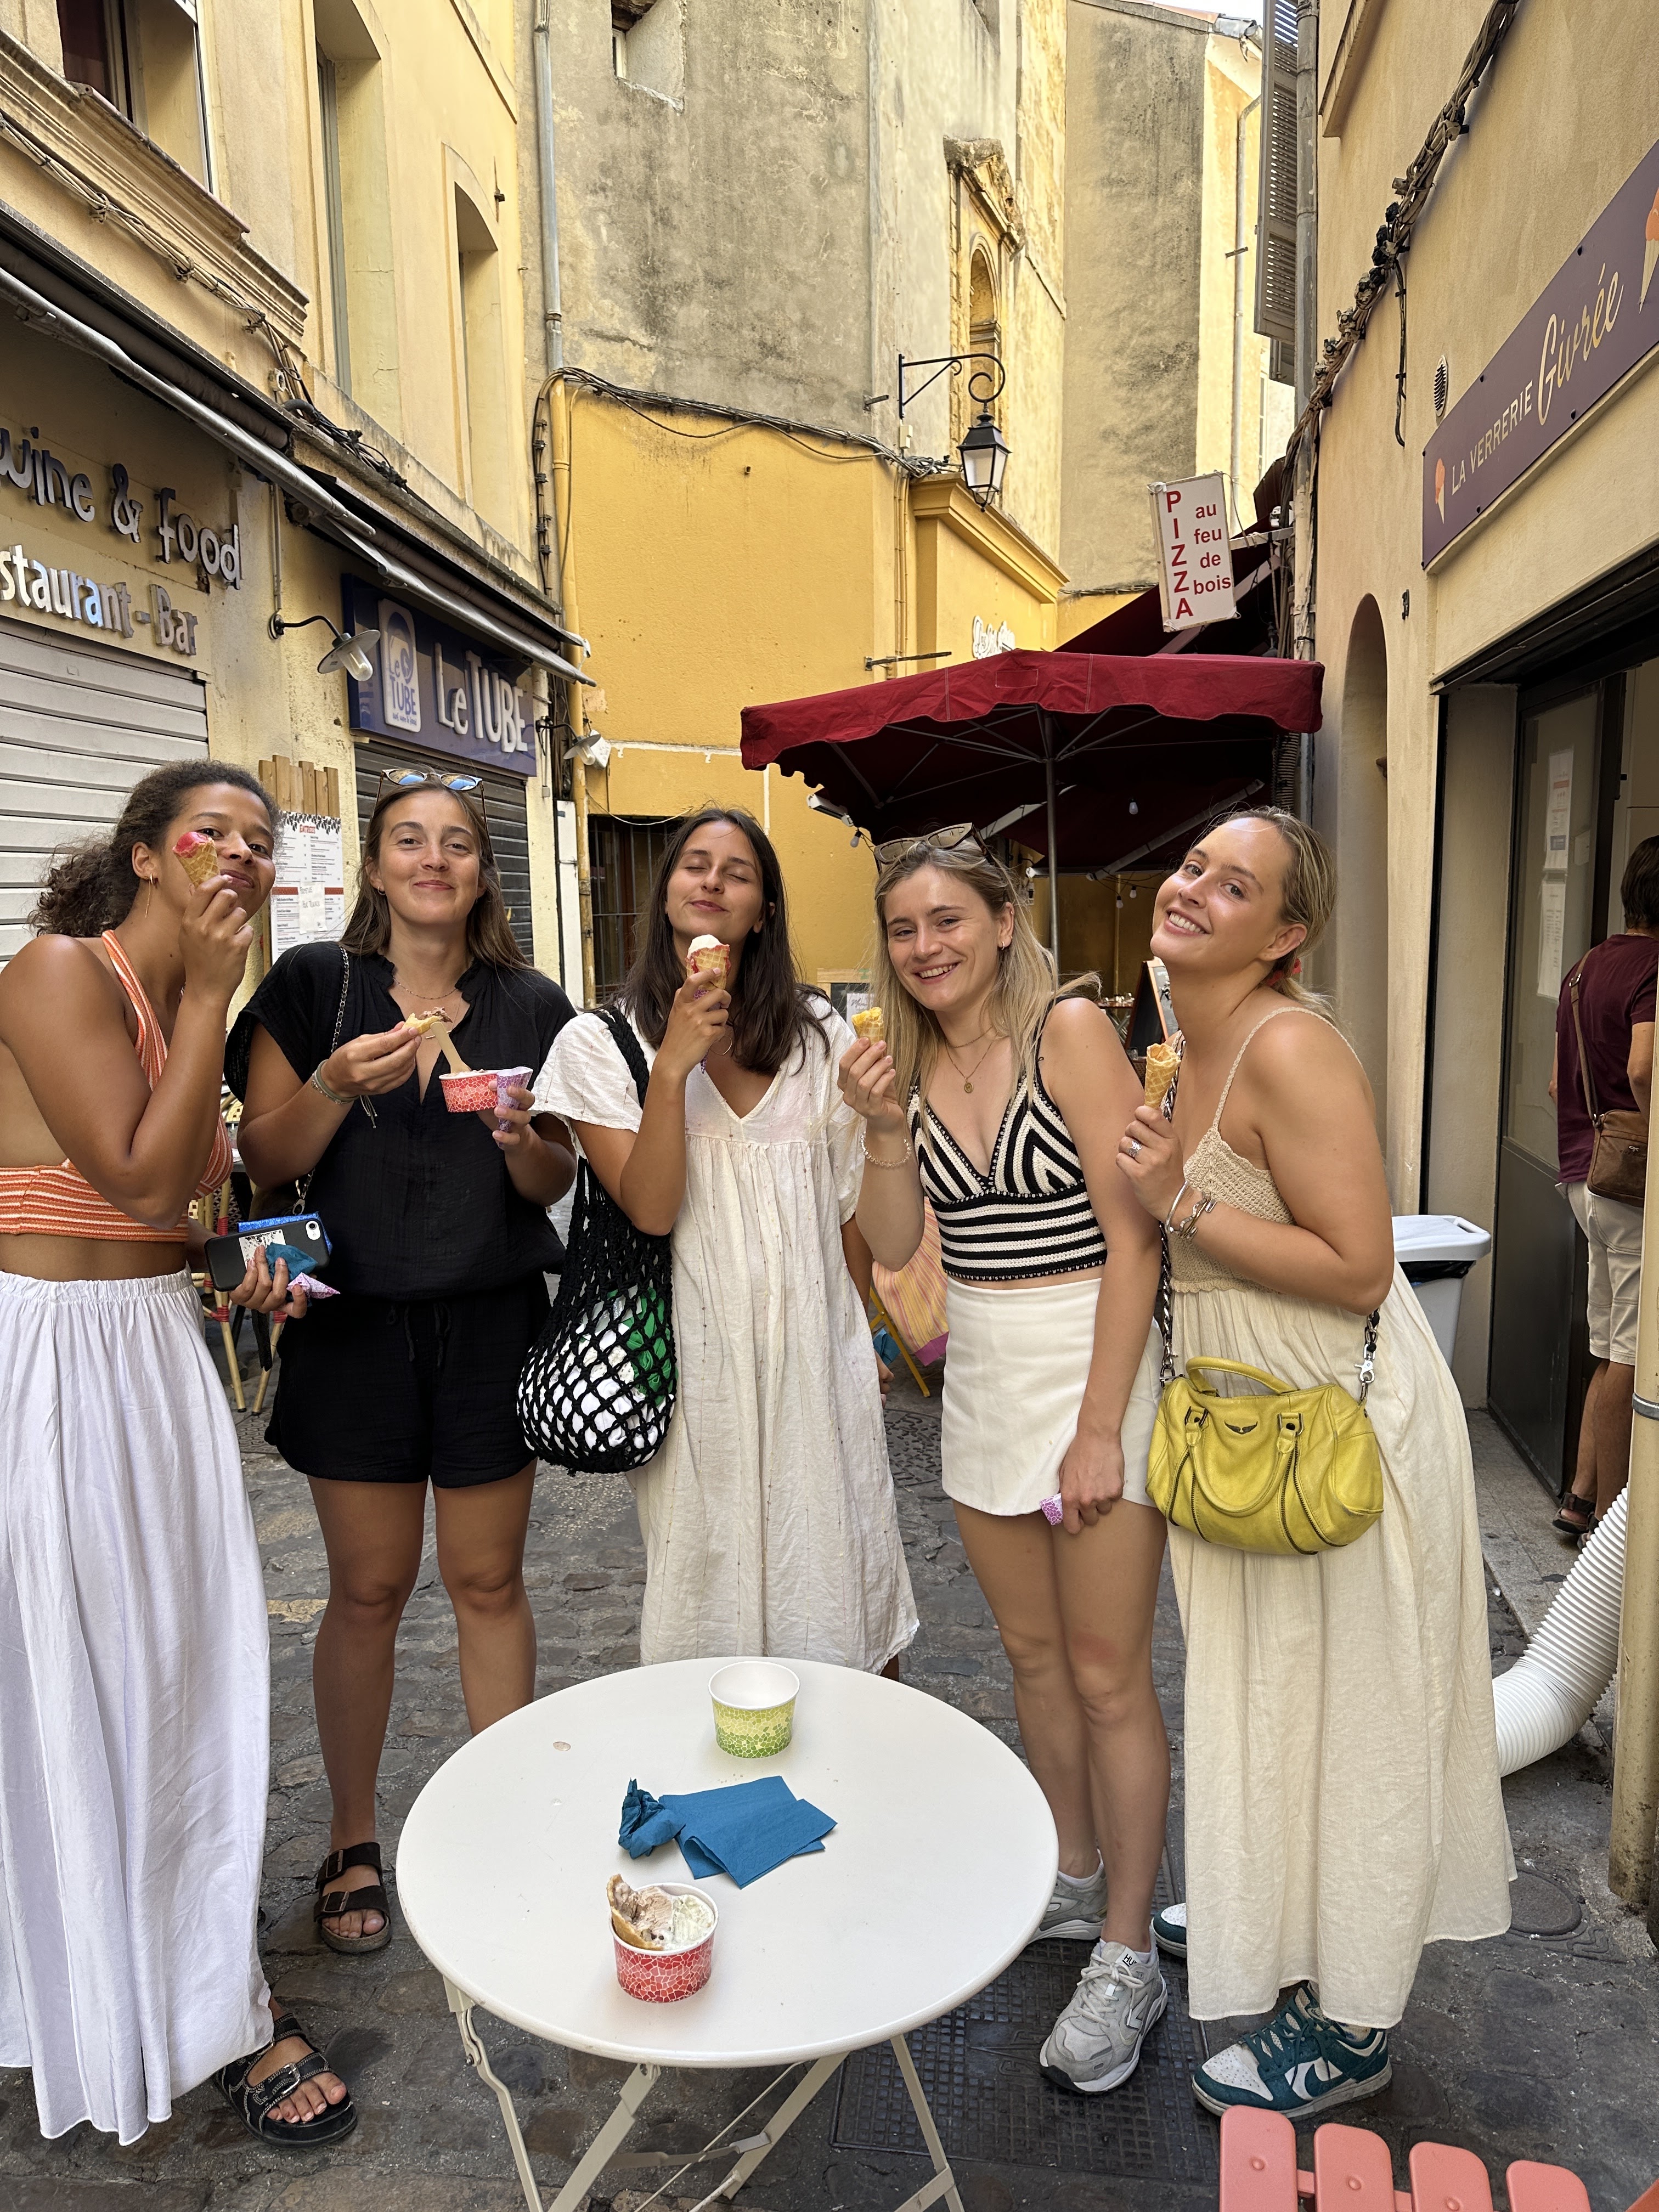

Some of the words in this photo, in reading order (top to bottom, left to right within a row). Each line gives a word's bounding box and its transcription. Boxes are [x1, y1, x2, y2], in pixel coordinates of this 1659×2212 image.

[1452, 460, 1466, 495] LA
[1470, 380, 1533, 474] VERRERIE
[1538, 262, 1624, 426] Givrée
[112, 464, 143, 543] &
[1195, 504, 1217, 518] au
[1194, 528, 1222, 544] feu
[1166, 490, 1193, 619] PIZZA
[1200, 552, 1221, 568] de
[1193, 575, 1232, 595] bois
[390, 675, 417, 715] TUBE
